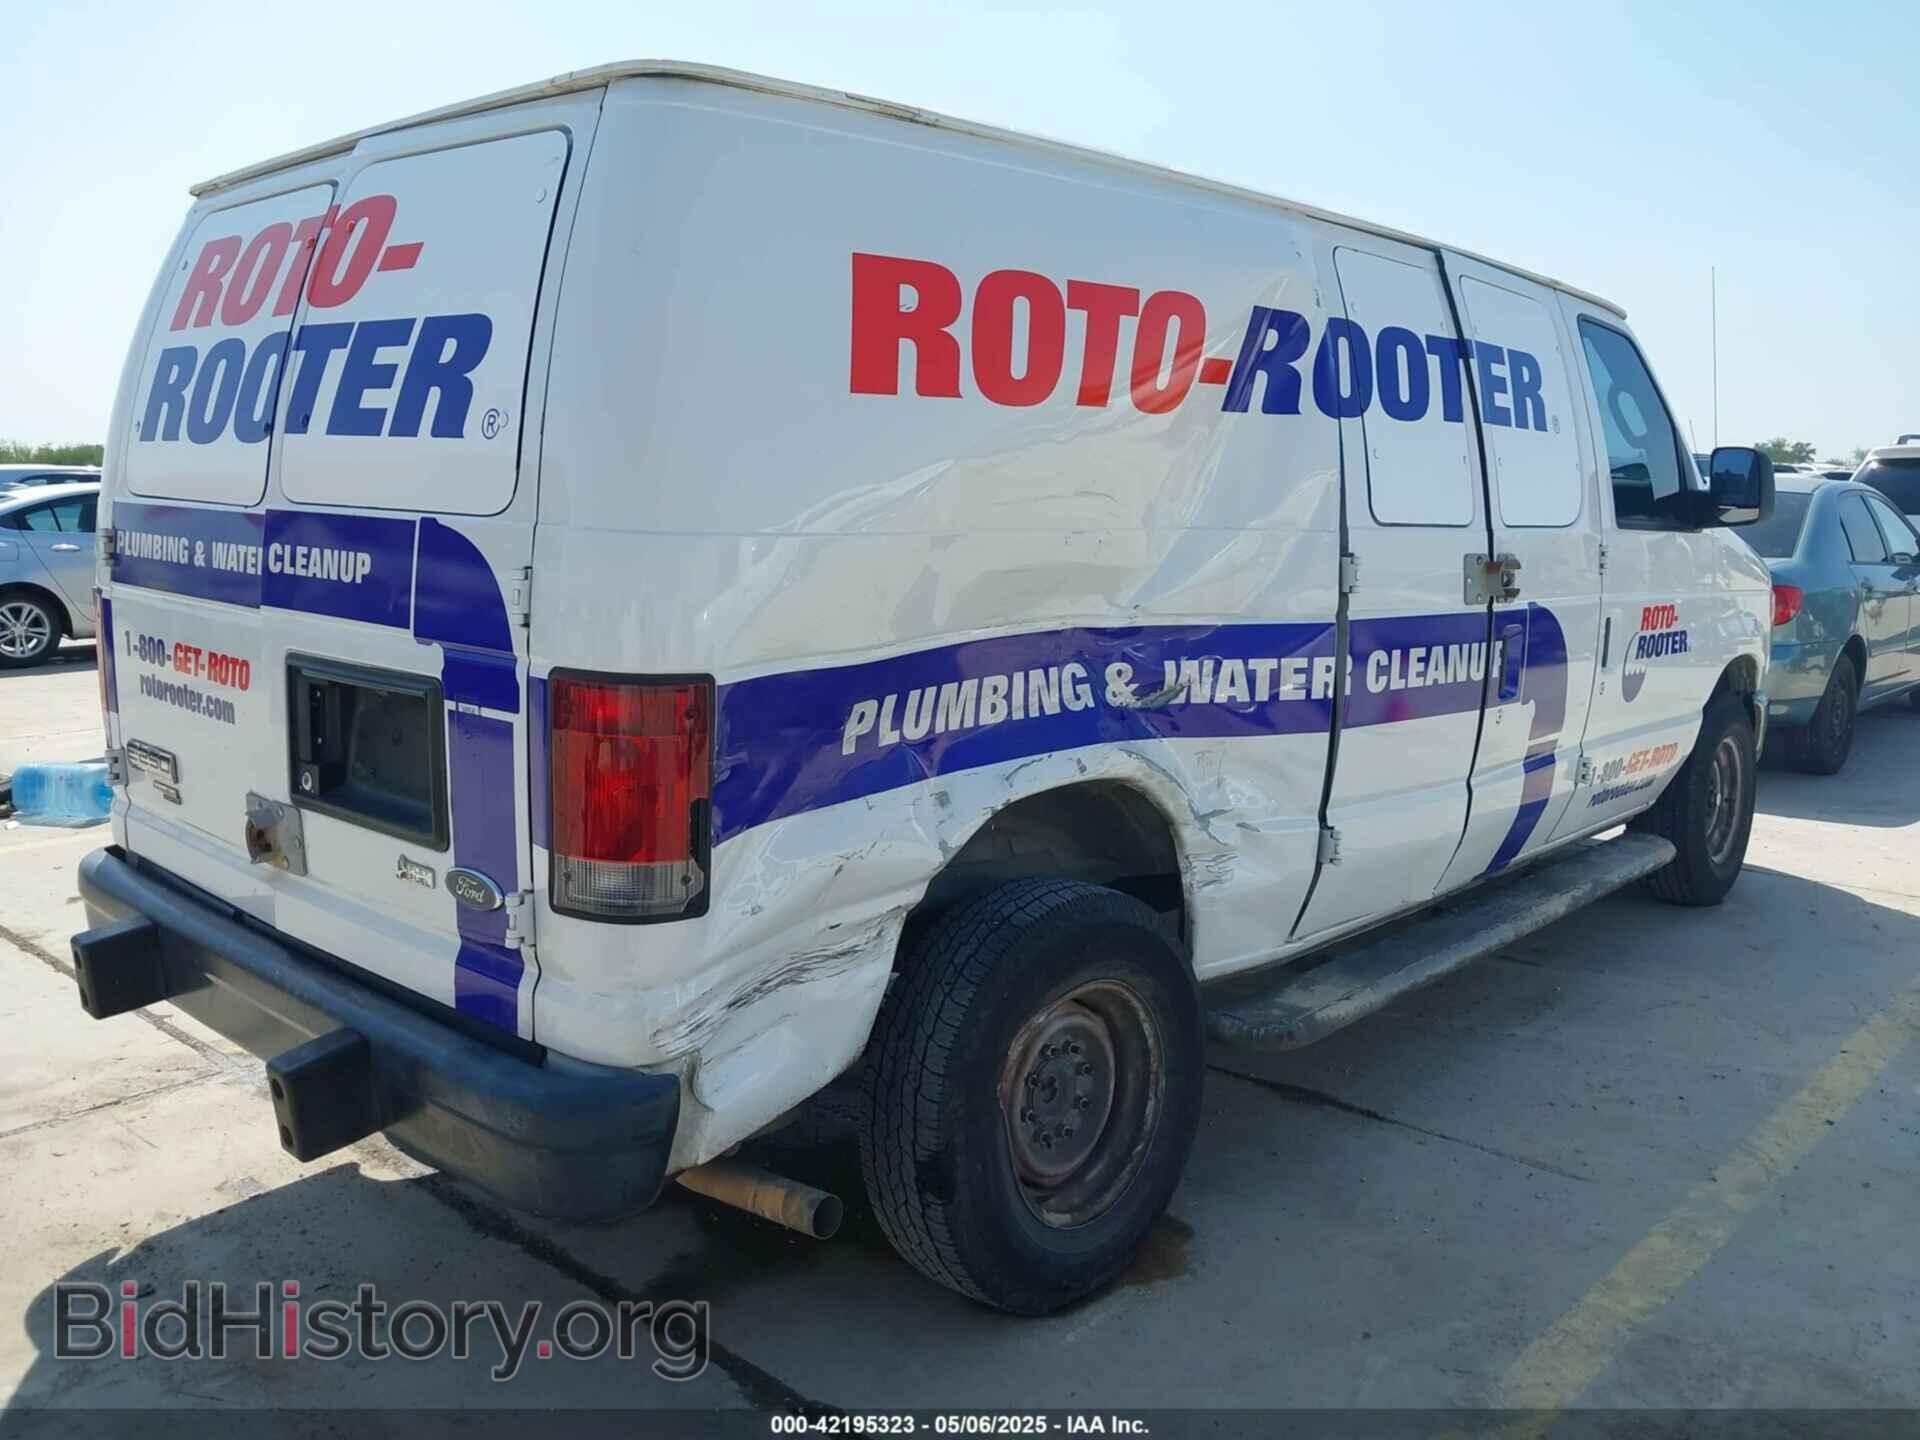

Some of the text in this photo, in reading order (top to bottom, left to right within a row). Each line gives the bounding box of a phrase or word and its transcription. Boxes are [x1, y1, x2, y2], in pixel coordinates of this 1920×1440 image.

[170, 194, 425, 332] ROTO-
[850, 251, 1548, 432] ROTO-ROOTER
[116, 530, 189, 565] PLUMBING
[193, 541, 206, 567] &
[268, 542, 372, 584] CLEANUP
[1635, 630, 1688, 660] ROOTER
[1640, 604, 1679, 632] ROTO-
[125, 630, 250, 691] 1-800-GET-ROTO
[140, 673, 236, 725] rotorooter.com
[841, 663, 1095, 756] PLUMBING
[1104, 662, 1140, 708] &
[1163, 655, 1353, 705] WATER
[455, 875, 486, 903] Ford
